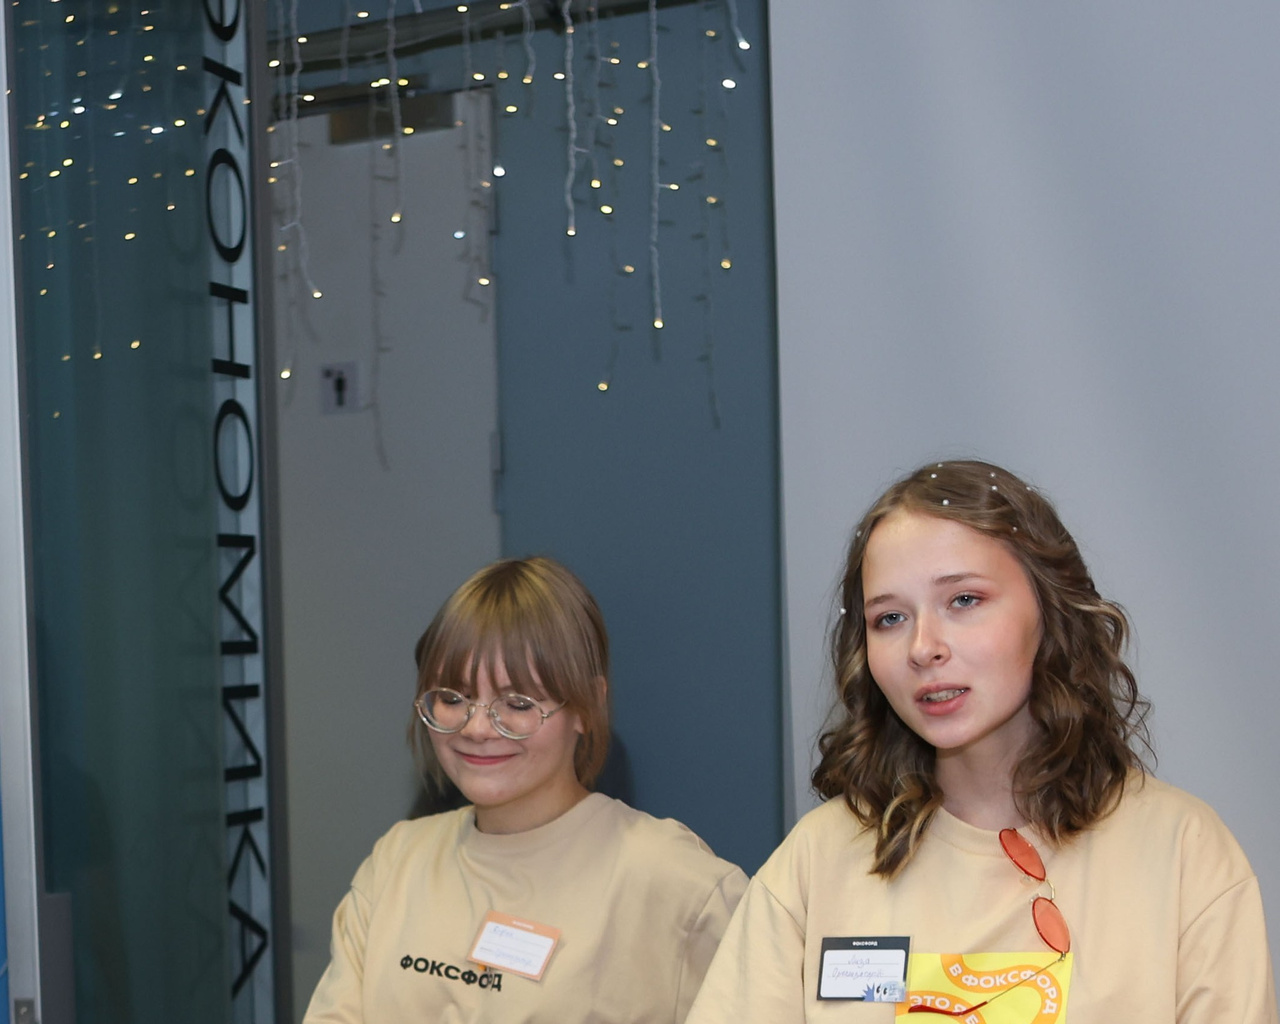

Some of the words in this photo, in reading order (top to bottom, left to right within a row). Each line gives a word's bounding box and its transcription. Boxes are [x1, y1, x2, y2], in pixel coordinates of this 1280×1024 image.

[400, 954, 503, 992] ФОКСФОД
[949, 963, 962, 976] В
[961, 969, 1057, 1014] ФОКСФОРД
[909, 995, 951, 1011] ЭТО
